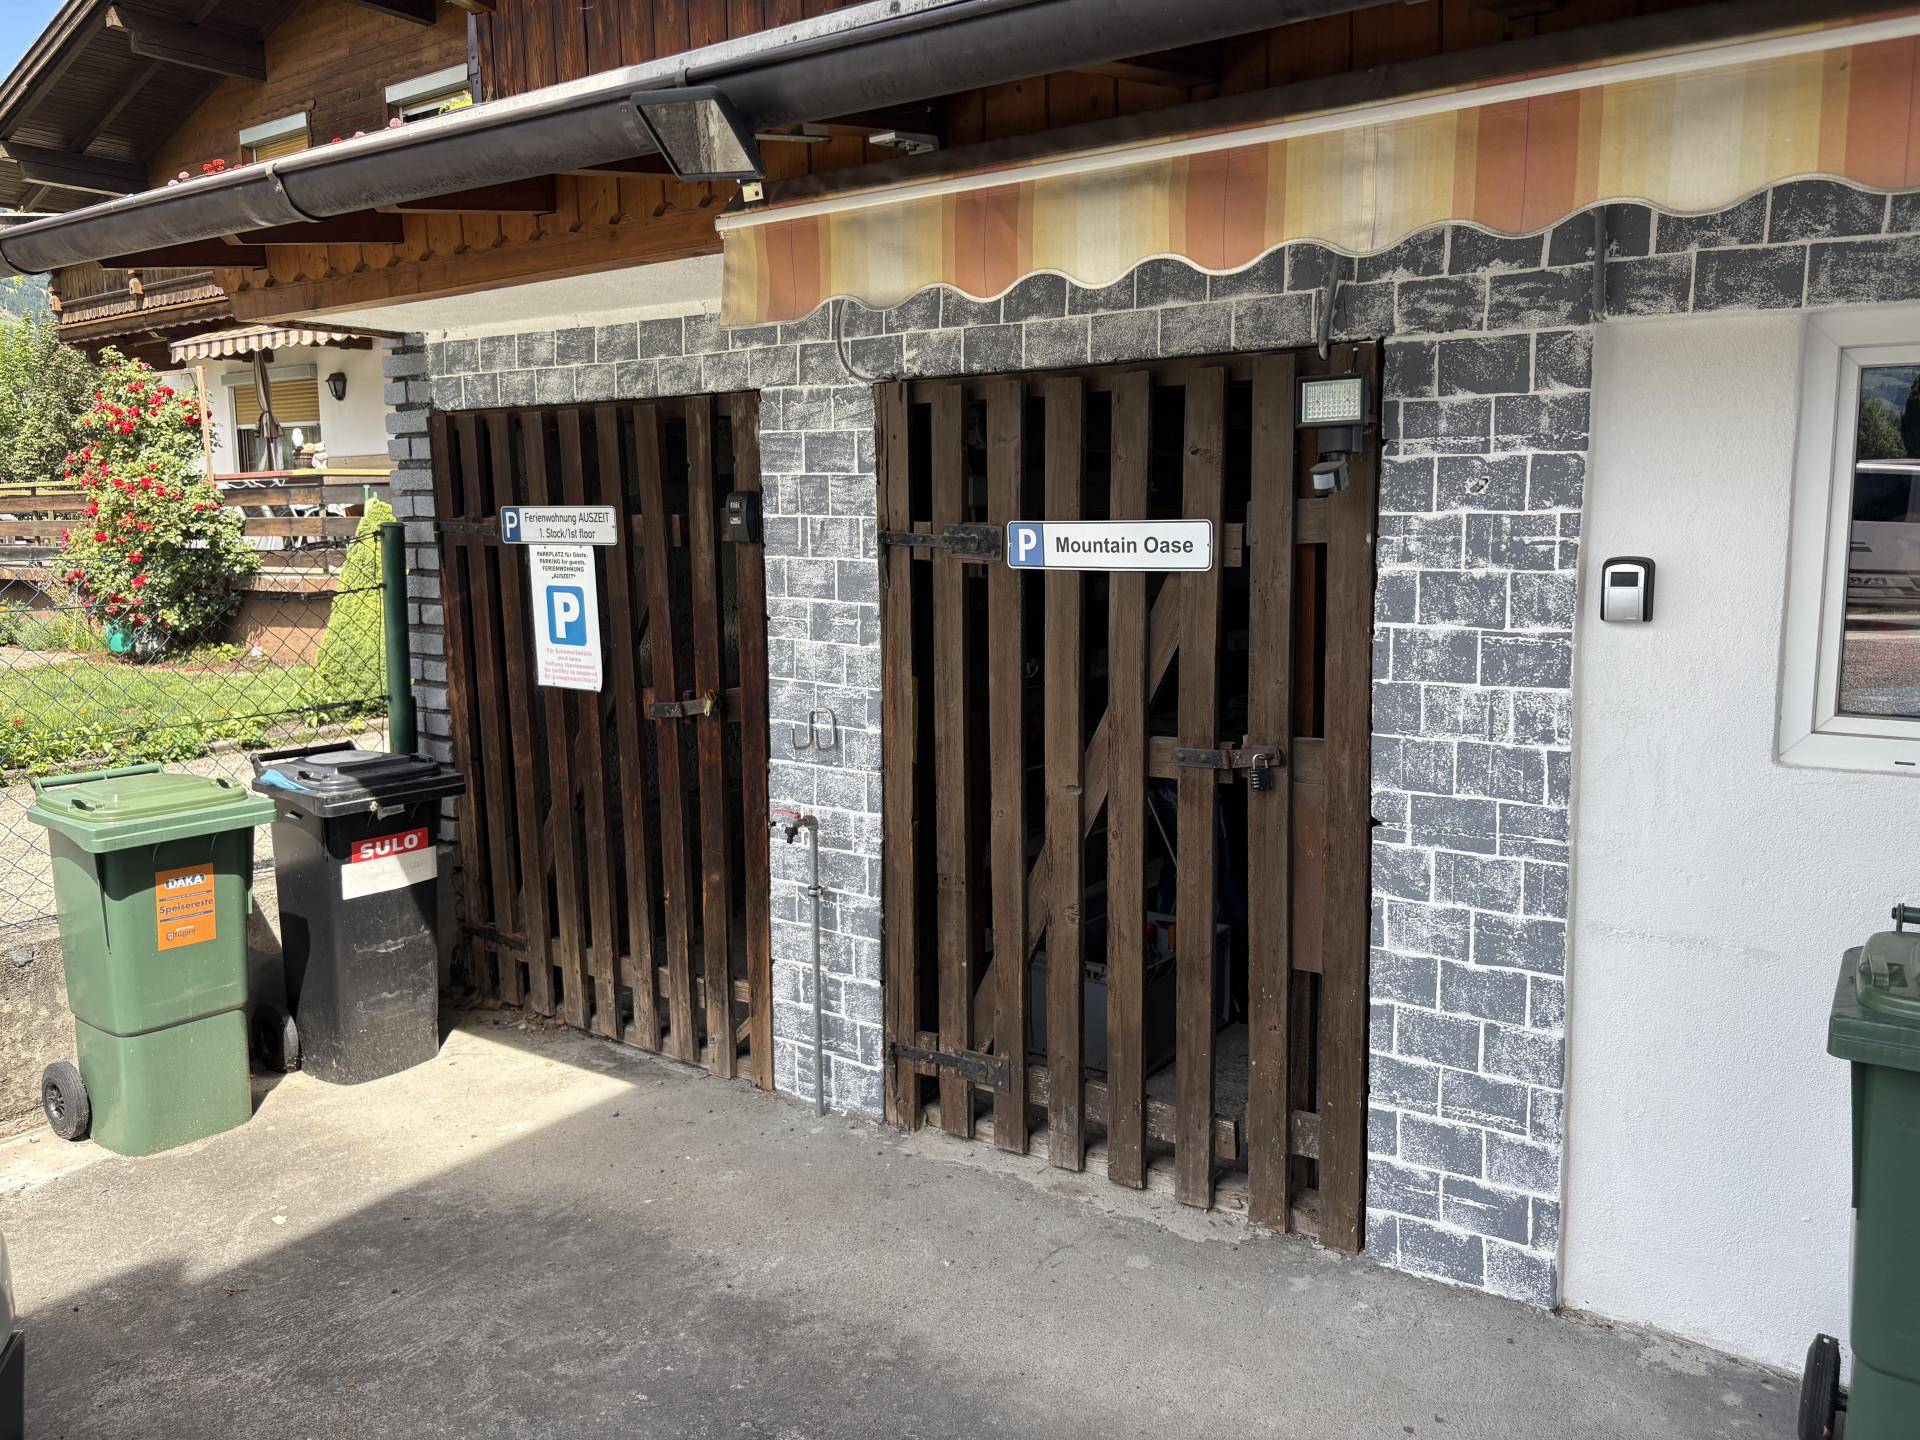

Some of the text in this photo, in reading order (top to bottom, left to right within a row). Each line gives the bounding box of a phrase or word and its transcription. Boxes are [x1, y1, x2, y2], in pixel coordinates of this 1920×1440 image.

[505, 511, 518, 538] P
[524, 512, 610, 525] Ferienwohnung AUSZEIT
[546, 528, 578, 539] Stock/1st
[579, 528, 596, 539] floor
[1018, 528, 1037, 562] P
[1056, 536, 1194, 554] Mountain Oase
[542, 565, 585, 573] FERIENWOHNUNG
[553, 591, 580, 639] P
[360, 833, 419, 859] SULO
[167, 874, 204, 889] DAKA
[160, 898, 214, 915] Speisereste
